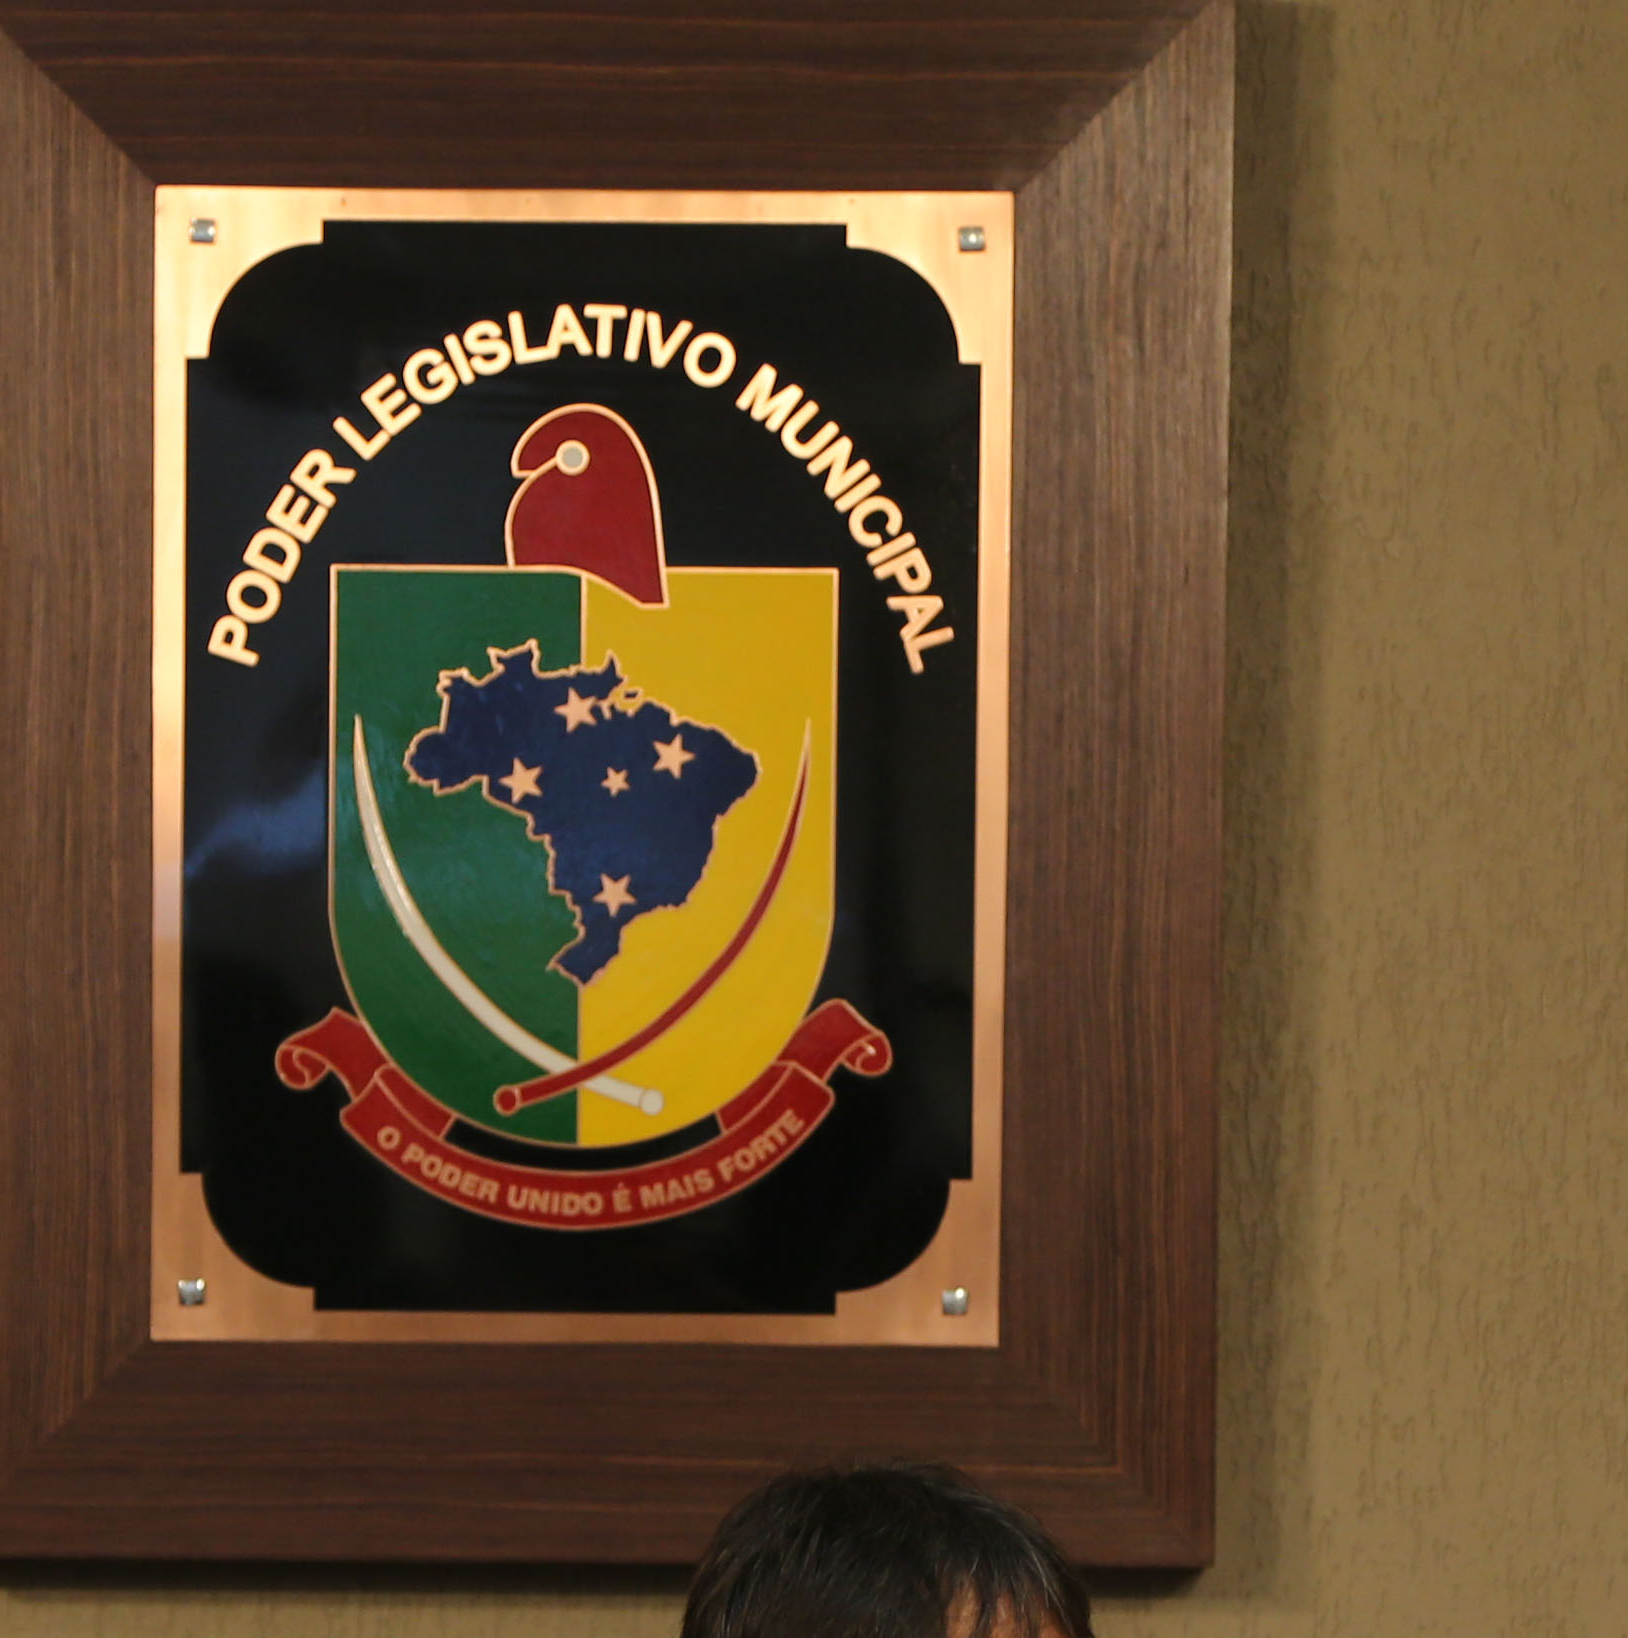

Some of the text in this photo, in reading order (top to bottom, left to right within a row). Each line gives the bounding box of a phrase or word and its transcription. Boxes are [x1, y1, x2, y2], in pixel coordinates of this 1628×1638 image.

[207, 303, 955, 675] PODER LEGISLATIVO MUNICIPAL
[377, 1109, 806, 1216] O PODER UNIDO É MAIS FORTE
